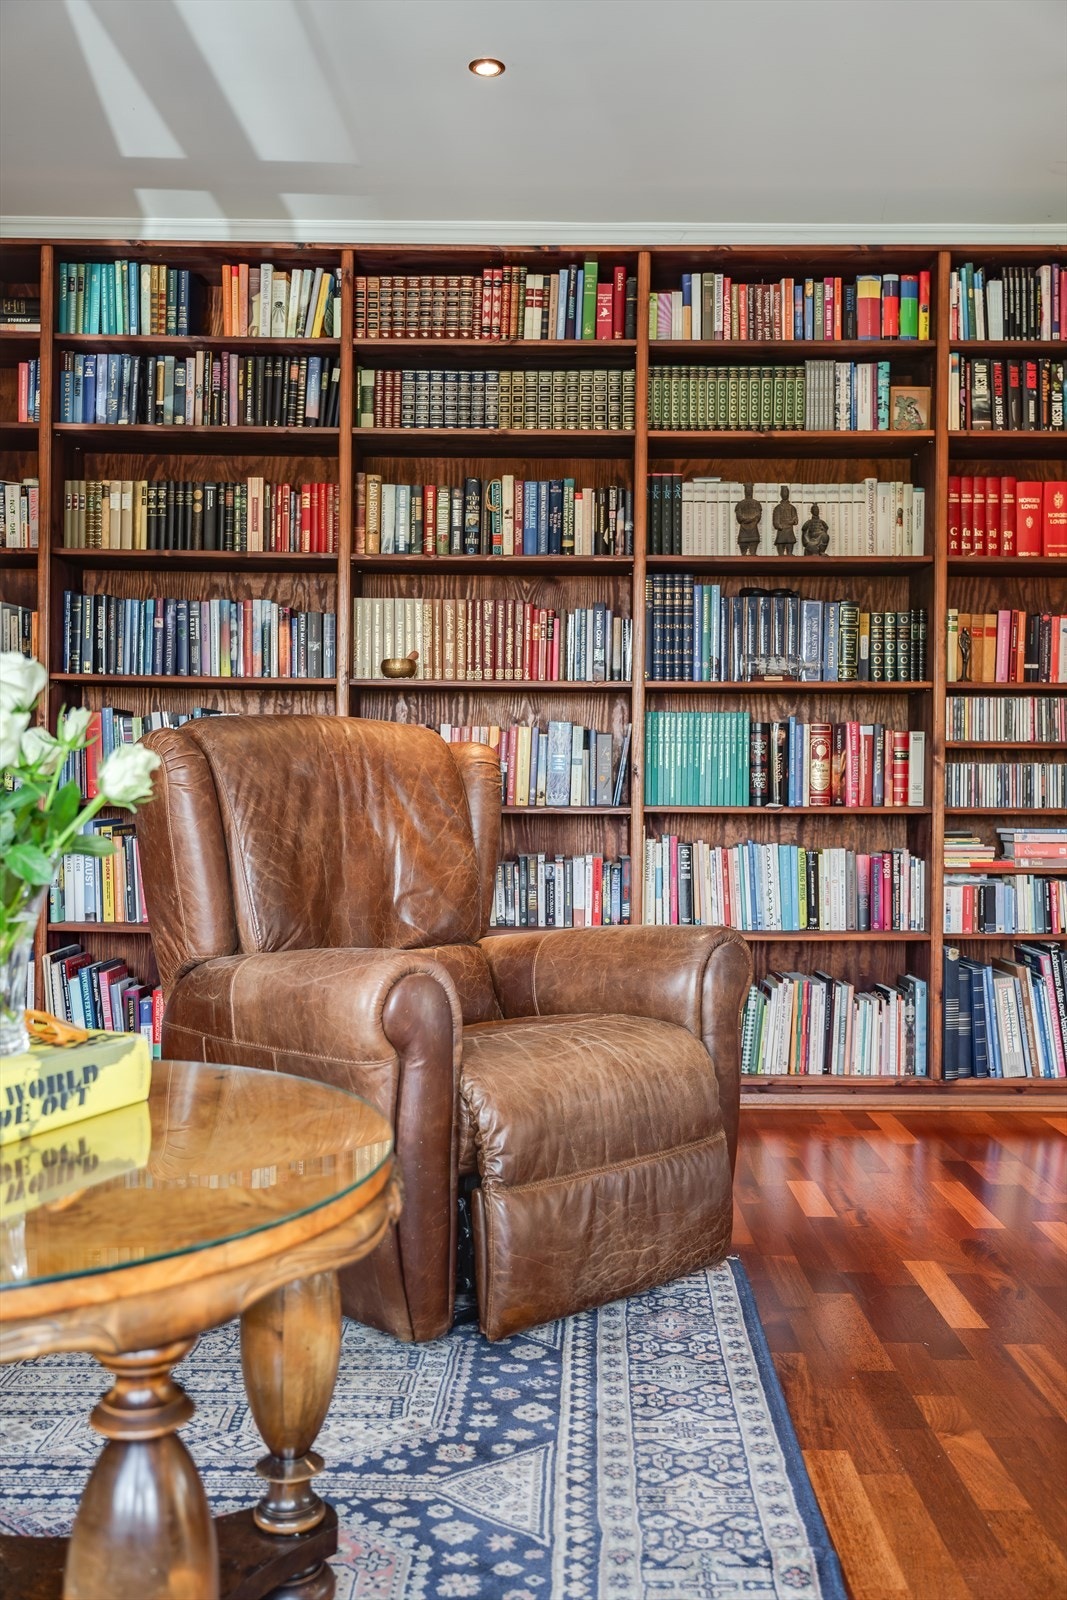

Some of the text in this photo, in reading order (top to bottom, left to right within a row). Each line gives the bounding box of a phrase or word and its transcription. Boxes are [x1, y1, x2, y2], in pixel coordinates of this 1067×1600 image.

[212, 362, 221, 392] LINDELL
[975, 363, 986, 373] JO
[995, 396, 1003, 404] JO
[1052, 391, 1063, 401] JO
[369, 483, 378, 530] DAN BROWN
[438, 492, 448, 535] DAN BROWN
[950, 527, 957, 536] C
[883, 858, 891, 879] yoga
[81, 972, 90, 1001] HVORDAN
[1046, 975, 1055, 1009] CONCISE
[85, 1001, 91, 1010] ER
[1050, 1009, 1059, 1031] WORLD
[1054, 1032, 1064, 1058] ATLAS
[5, 1065, 99, 1106] WORLD
[41, 1087, 88, 1116] OUT
